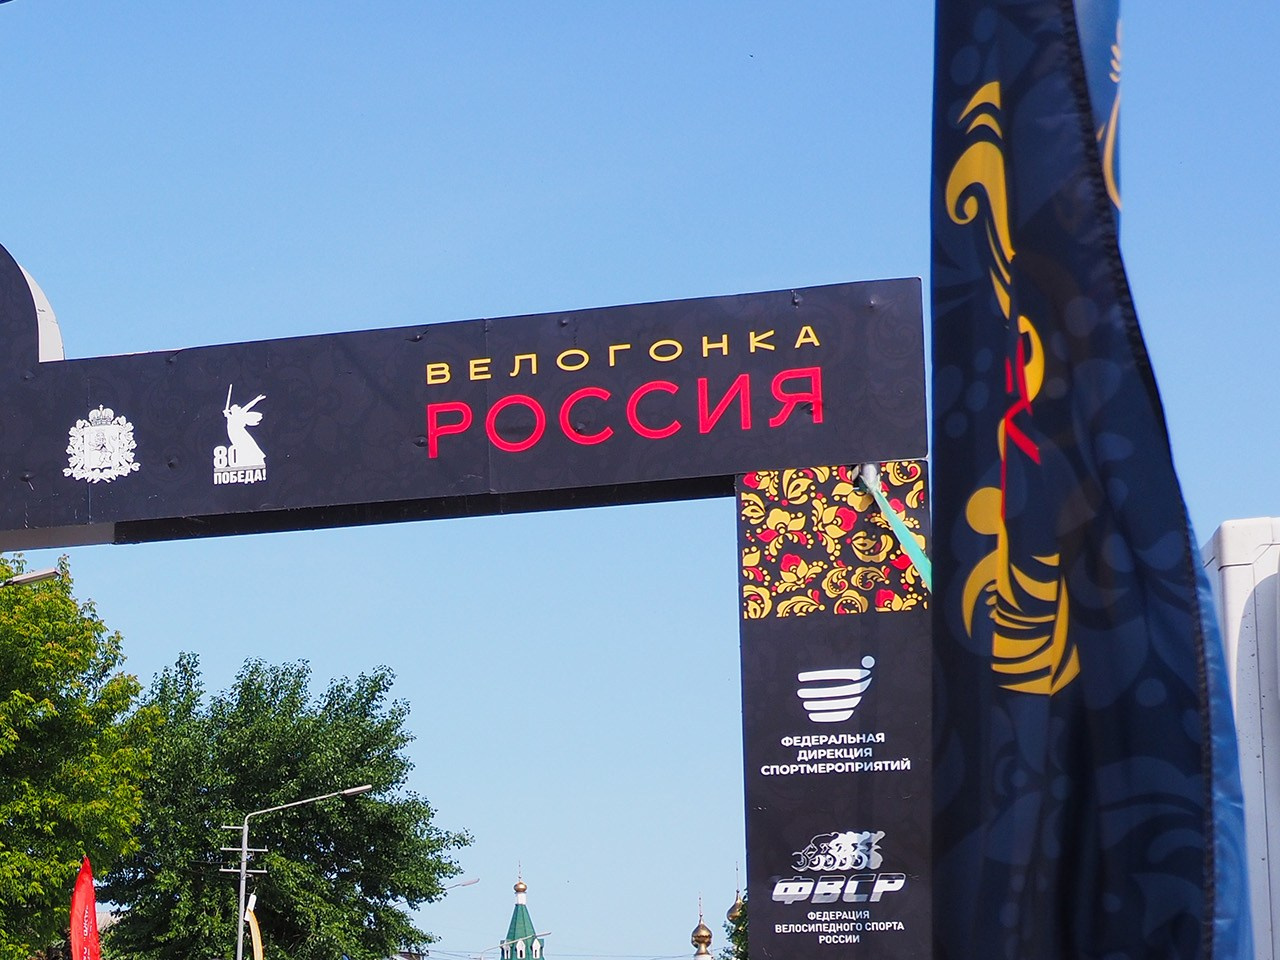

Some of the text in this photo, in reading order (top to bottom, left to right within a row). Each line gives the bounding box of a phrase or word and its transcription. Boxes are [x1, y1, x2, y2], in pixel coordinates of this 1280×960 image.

[426, 325, 821, 385] ВЕЛОГОНКА
[426, 366, 824, 459] РОССИЯ
[213, 467, 268, 485] ПОБЕДА!
[780, 732, 886, 748] ФЕДЕРАЛЬНАЯ
[796, 747, 873, 762] ДИРЕКЦИЯ
[760, 757, 912, 777] СПОРТМЕРОПРИЯТИЙ
[771, 872, 907, 905] ФВСР
[807, 910, 870, 923] ФЕДЕРАЦИЯ
[774, 920, 905, 935] ВЕЛОСИПЕДНОГО СПОРТА
[818, 934, 861, 945] РОССИИ
